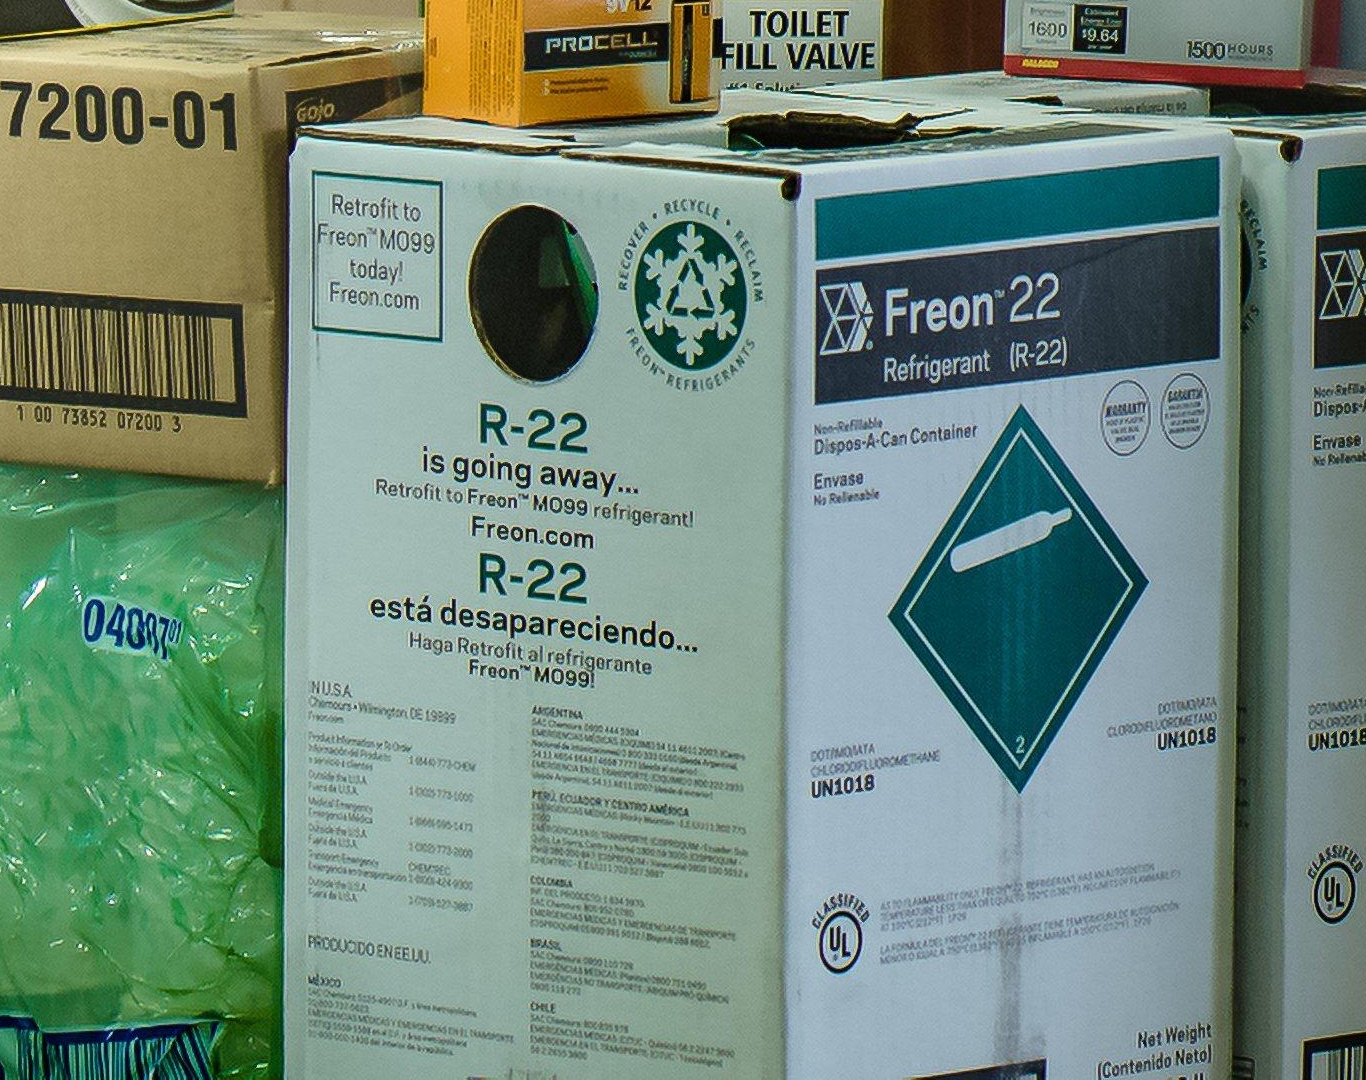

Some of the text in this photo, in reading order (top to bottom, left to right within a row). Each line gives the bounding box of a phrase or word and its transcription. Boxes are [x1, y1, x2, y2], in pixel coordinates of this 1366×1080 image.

[749, 10, 850, 38] TOILET
[1081, 29, 1119, 43] $9.64
[545, 31, 658, 54] PROCELL
[722, 42, 875, 70] FILL VALVE
[1187, 40, 1274, 60] 1500 HOURS
[0, 80, 238, 152] 7200-01
[331, 194, 422, 223] Retrofit to
[664, 198, 721, 220] RECYCLE
[617, 220, 650, 291] RECOVER
[734, 229, 765, 303] RECLAIM
[349, 259, 403, 283] today!
[329, 282, 420, 311] Freon.com
[1009, 271, 1061, 323] 22
[883, 336, 1068, 384] Refrigerant (R-22)
[16, 404, 182, 433] 1 00 73852 07200 3
[477, 403, 588, 454] R-22
[910, 423, 979, 445] Container
[1313, 433, 1363, 451] Envase
[422, 446, 639, 496] is going away...
[813, 471, 864, 490] Envase
[375, 478, 442, 502] Retrofit
[445, 486, 464, 505] to
[593, 502, 694, 528] refrigerant!
[471, 515, 595, 550] Freon.com
[478, 551, 588, 605] R-22
[369, 597, 699, 654] está desapareciendo...
[409, 632, 652, 677] Haga Retrofit al refrigerante
[1015, 735, 1025, 755] 2
[1157, 726, 1217, 751] UN1018
[811, 774, 876, 799] UN1018
[1307, 844, 1365, 881] CLASSIFIED
[1324, 875, 1345, 909] UL
[811, 892, 871, 930] CLASSIFIED
[829, 925, 851, 959] UL
[1138, 1022, 1212, 1049] Net Weight
